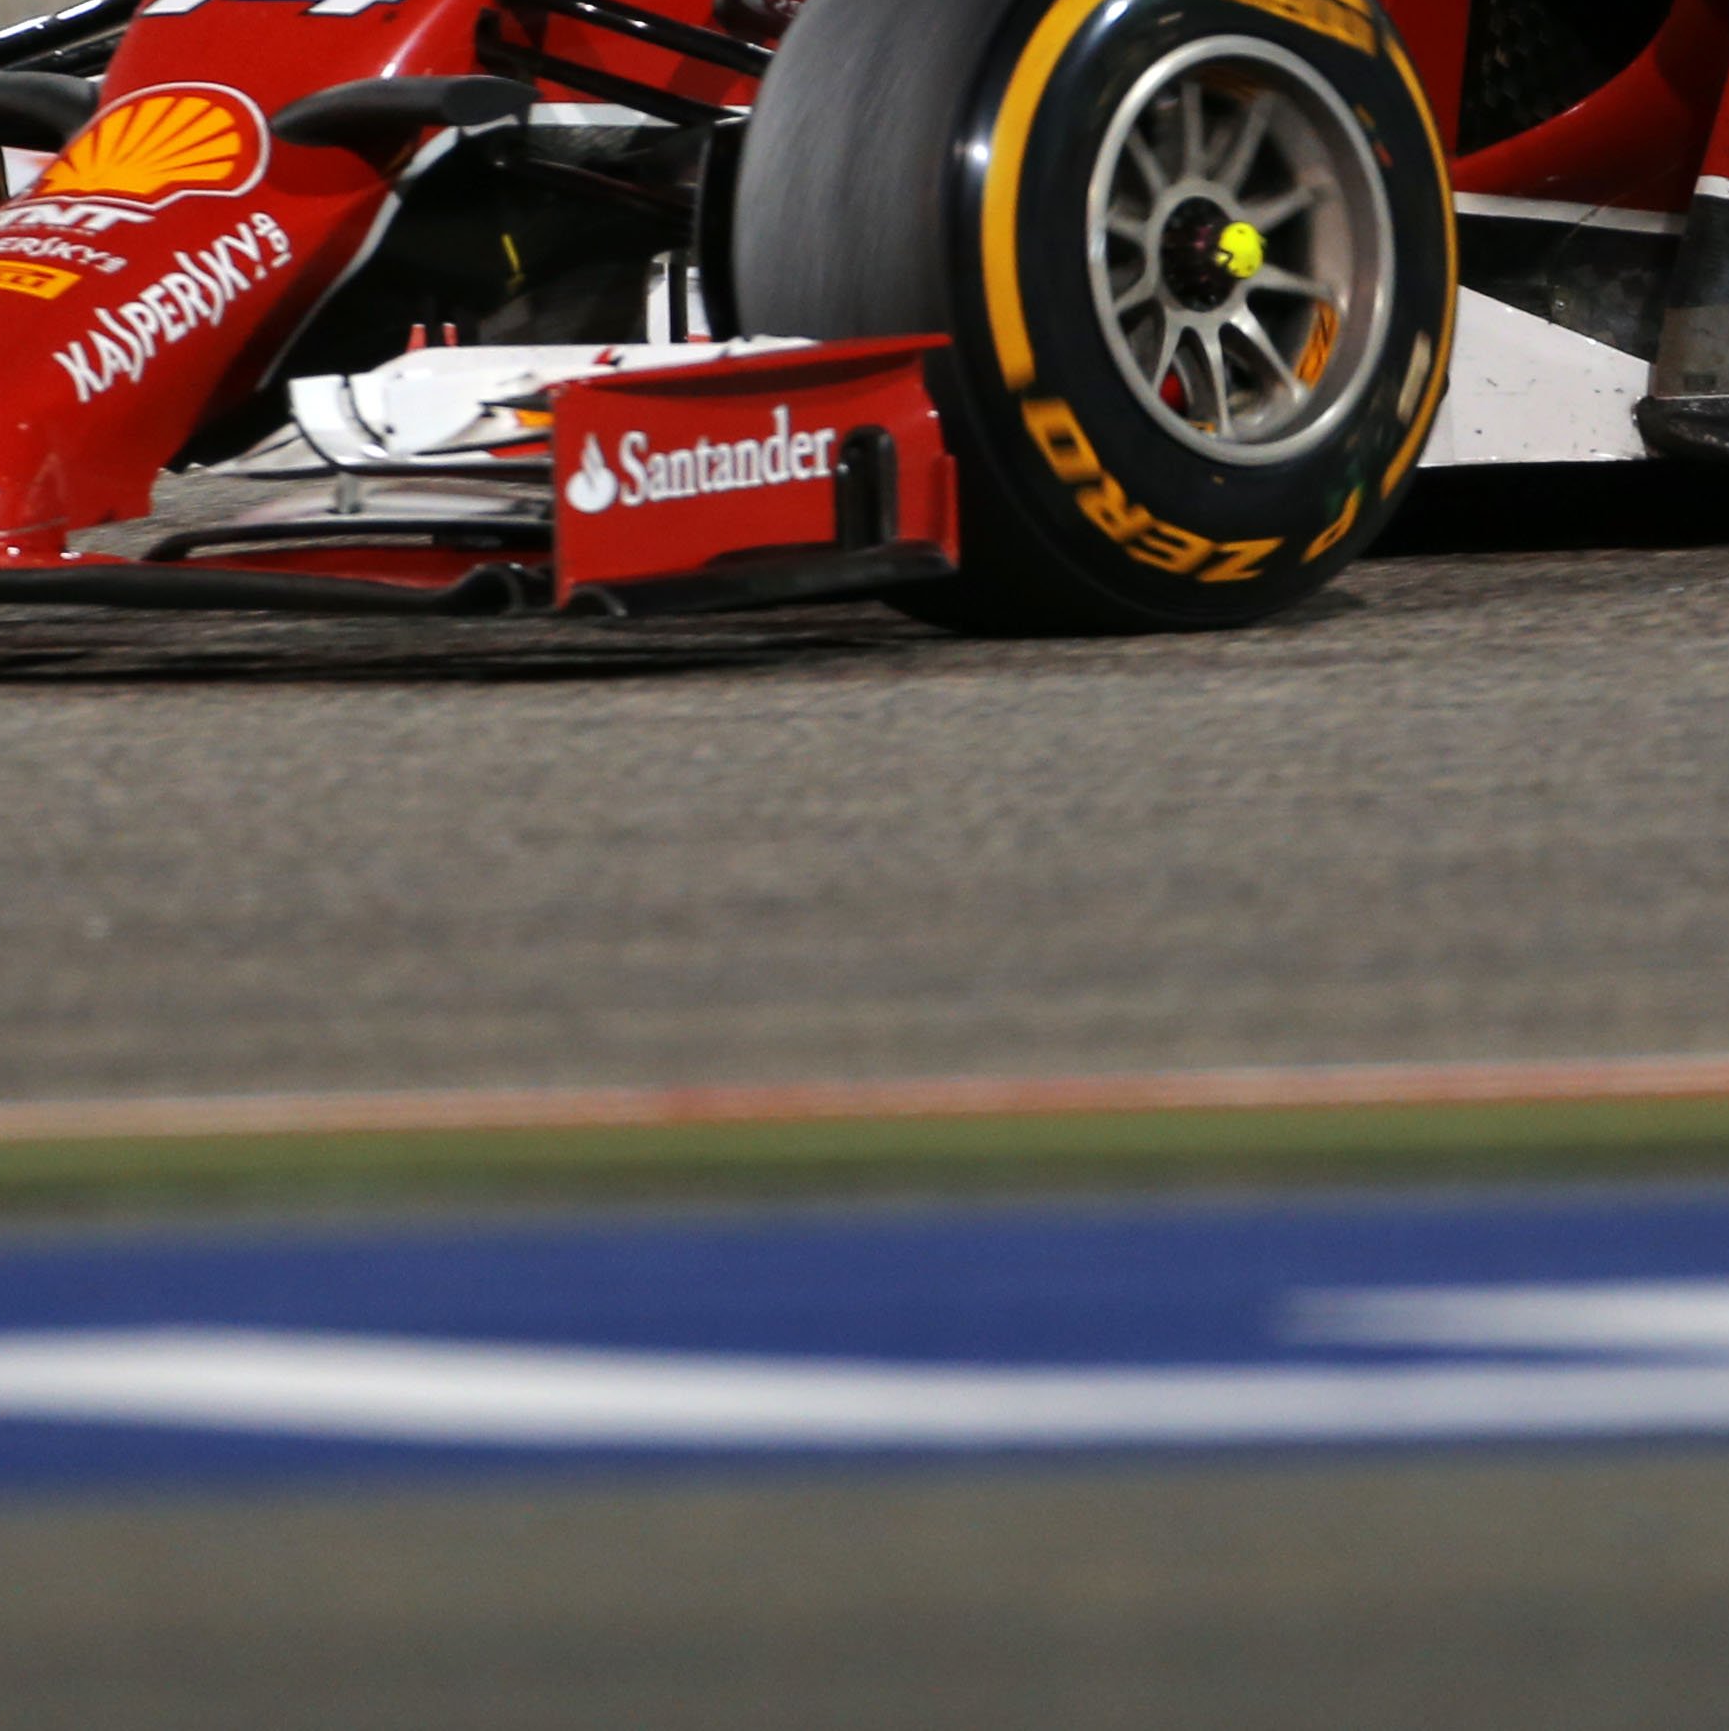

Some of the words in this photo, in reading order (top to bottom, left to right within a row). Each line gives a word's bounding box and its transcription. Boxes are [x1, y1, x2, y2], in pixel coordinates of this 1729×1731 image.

[52, 222, 268, 403] KASPERSKY
[618, 404, 838, 508] Santander
[1020, 398, 1286, 584] ZERO
